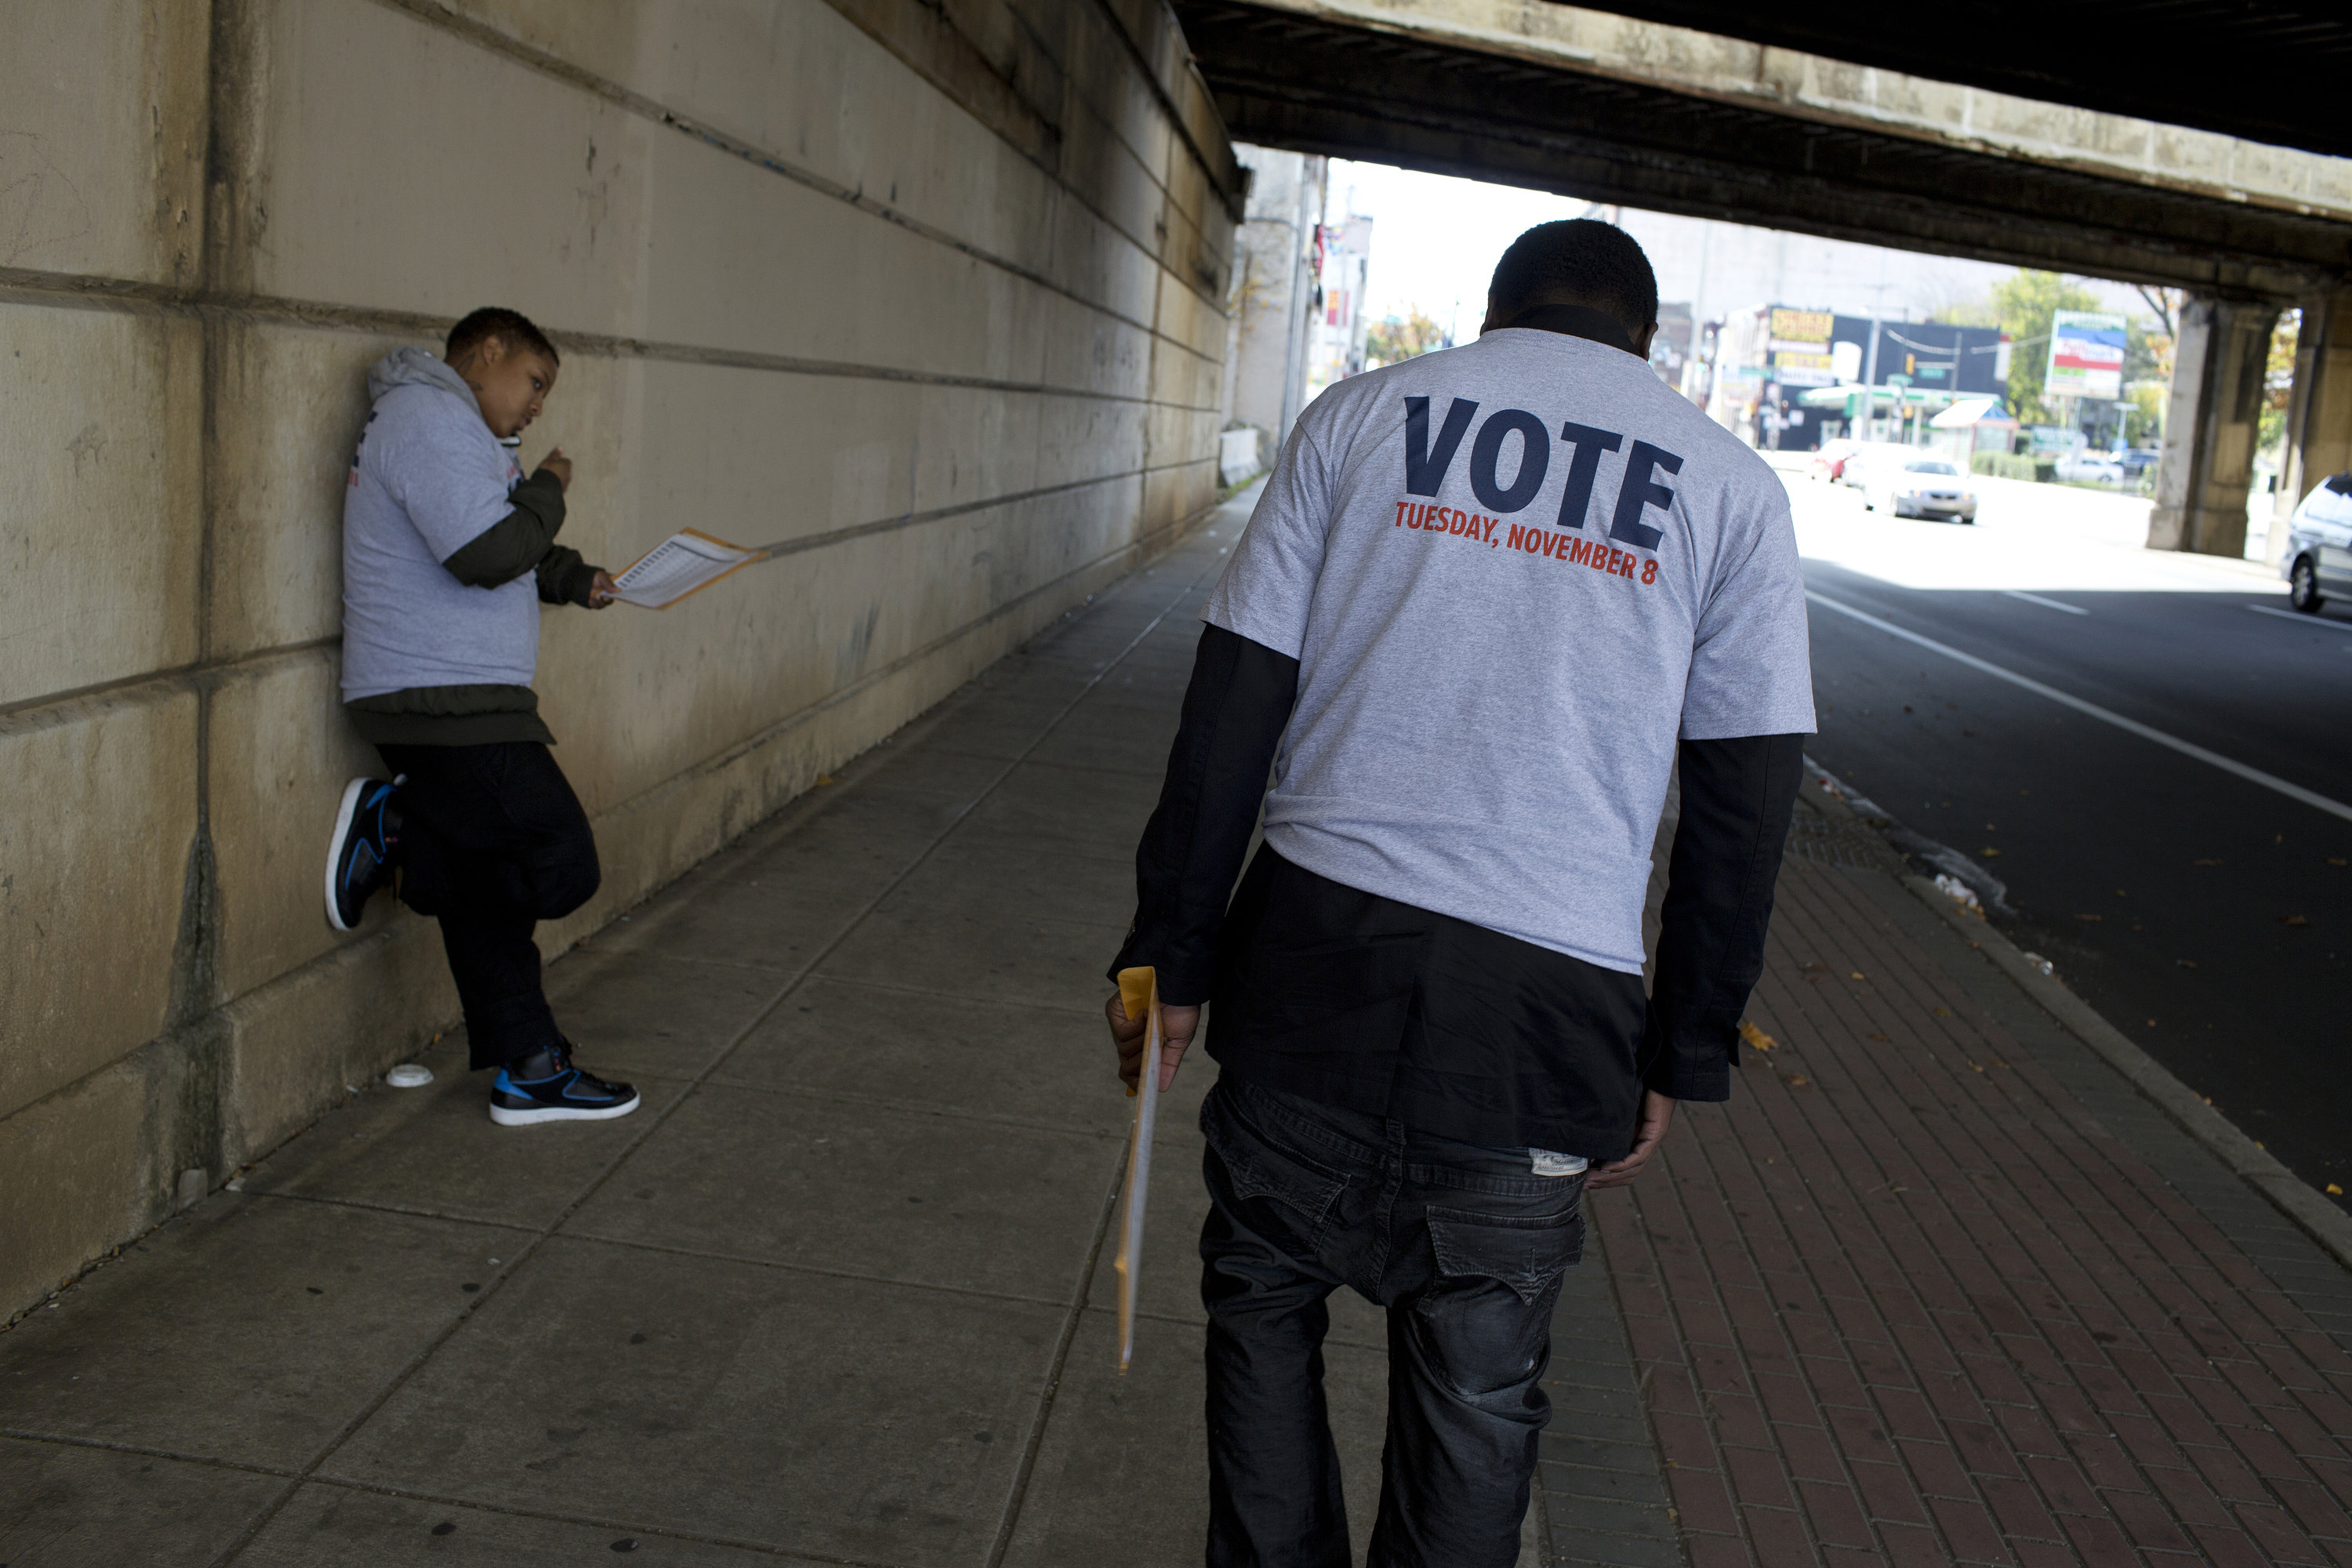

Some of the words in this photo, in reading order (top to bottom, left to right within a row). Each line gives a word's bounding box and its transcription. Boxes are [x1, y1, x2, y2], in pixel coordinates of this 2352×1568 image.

[1404, 396, 1684, 552] VOTE
[1395, 502, 1499, 549] TUESDAY,
[1506, 523, 1637, 579] NOVEMBER
[1640, 559, 1659, 585] 8
